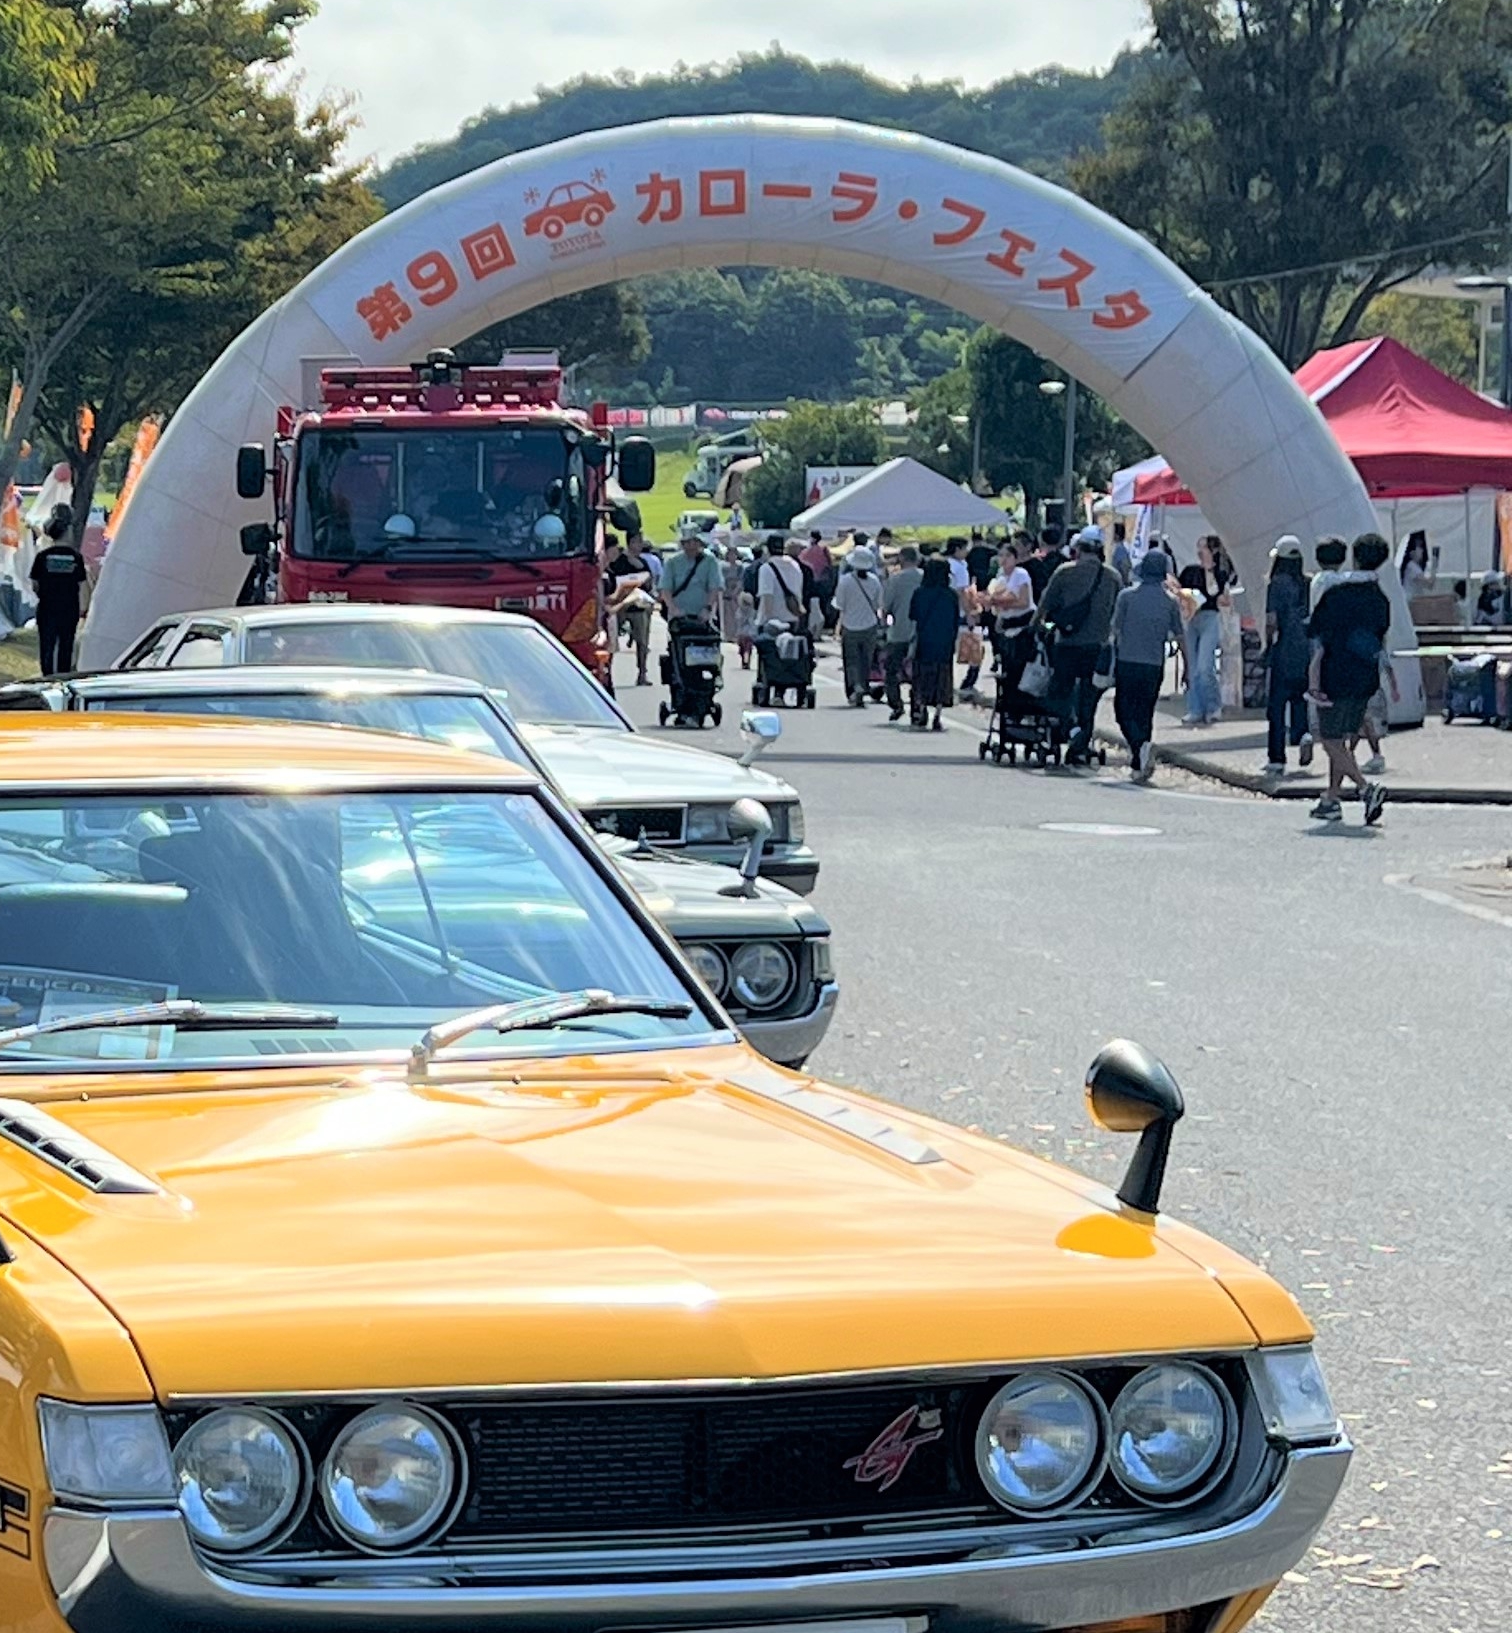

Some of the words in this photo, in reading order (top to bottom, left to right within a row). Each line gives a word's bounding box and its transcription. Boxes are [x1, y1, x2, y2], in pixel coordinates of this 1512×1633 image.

[356, 222, 516, 342] 第9回
[635, 169, 1153, 330] カローラ・フェスタ
